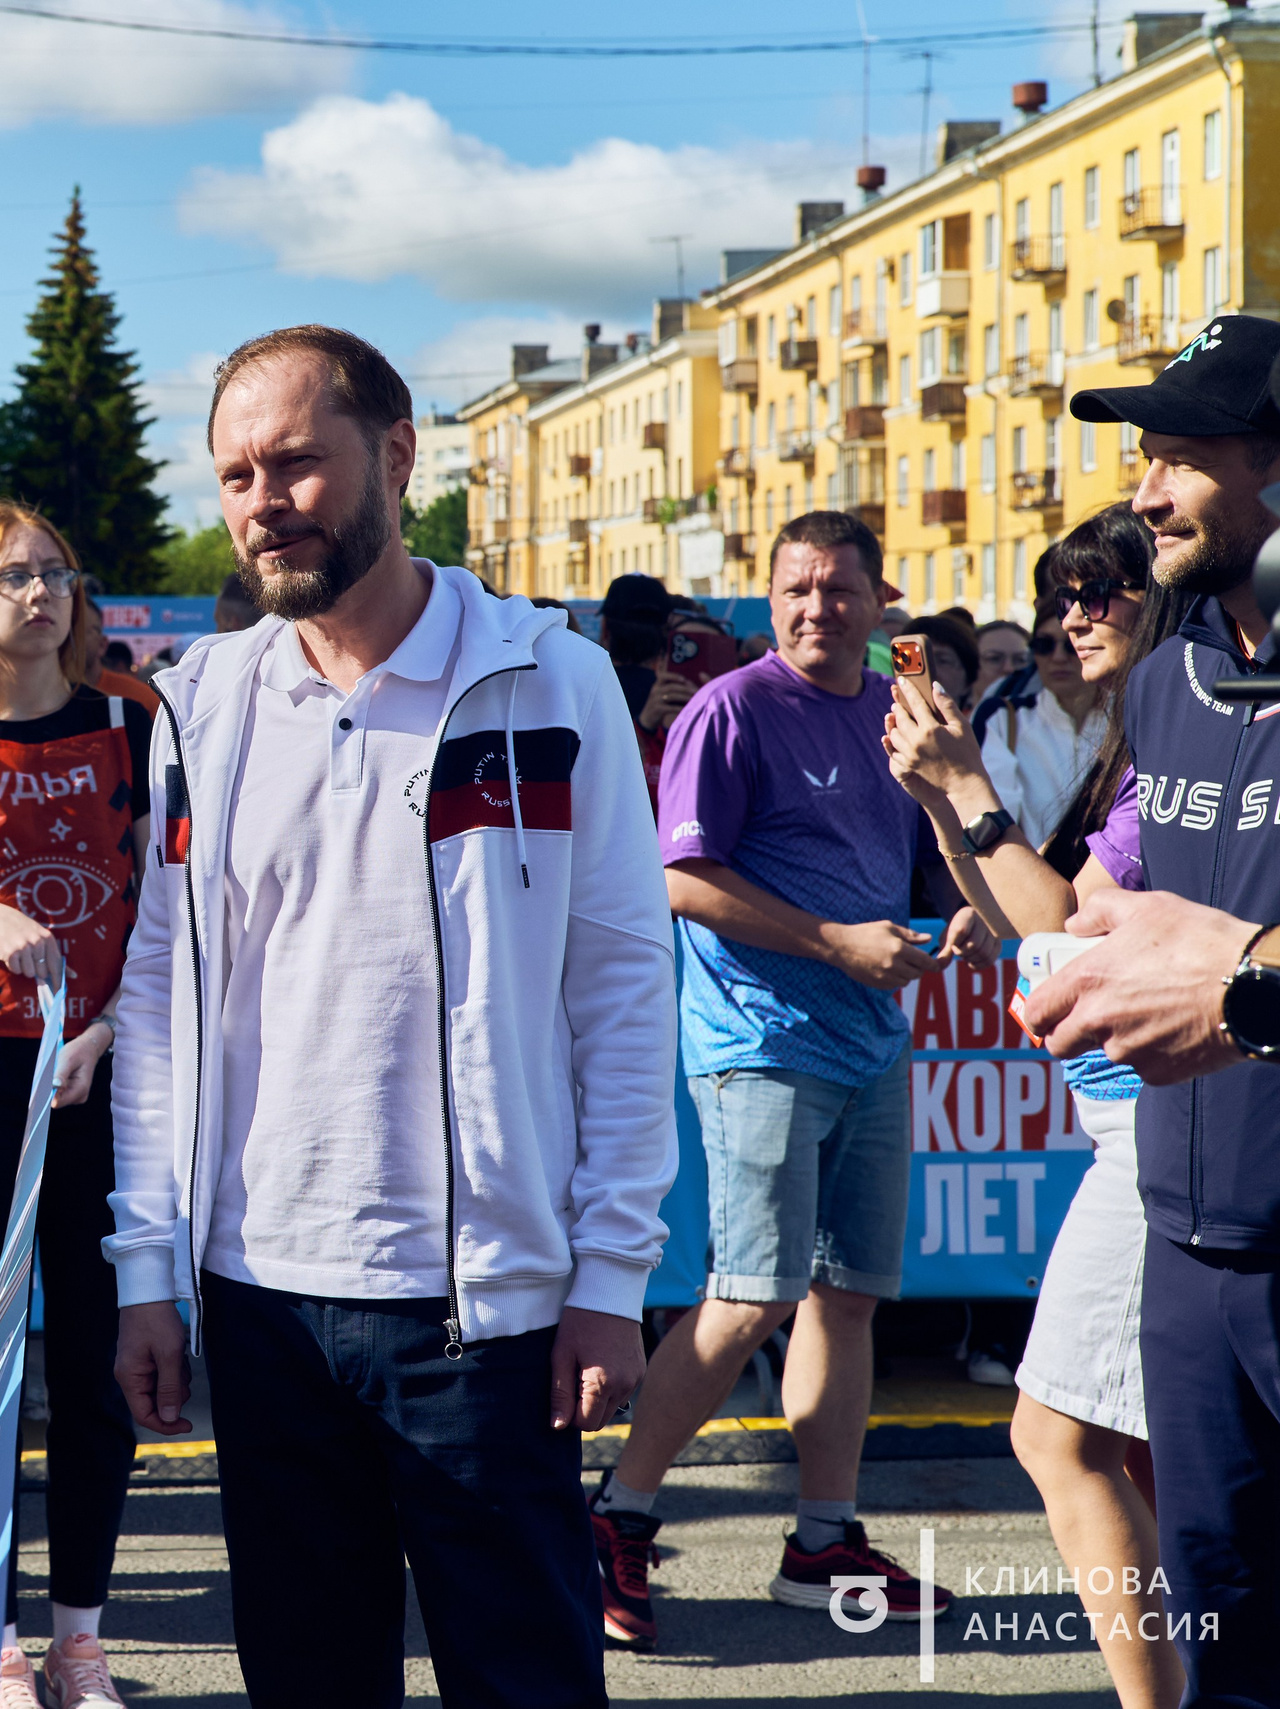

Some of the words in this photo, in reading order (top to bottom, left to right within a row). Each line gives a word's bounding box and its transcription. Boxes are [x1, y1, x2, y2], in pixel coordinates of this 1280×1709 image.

[1183, 641, 1195, 682] RUSSIAN
[1190, 677, 1213, 708] OLYMPIC
[1211, 700, 1235, 716] TEAM
[474, 751, 495, 785] PUTIN
[920, 1162, 1046, 1255] ЛЕТ
